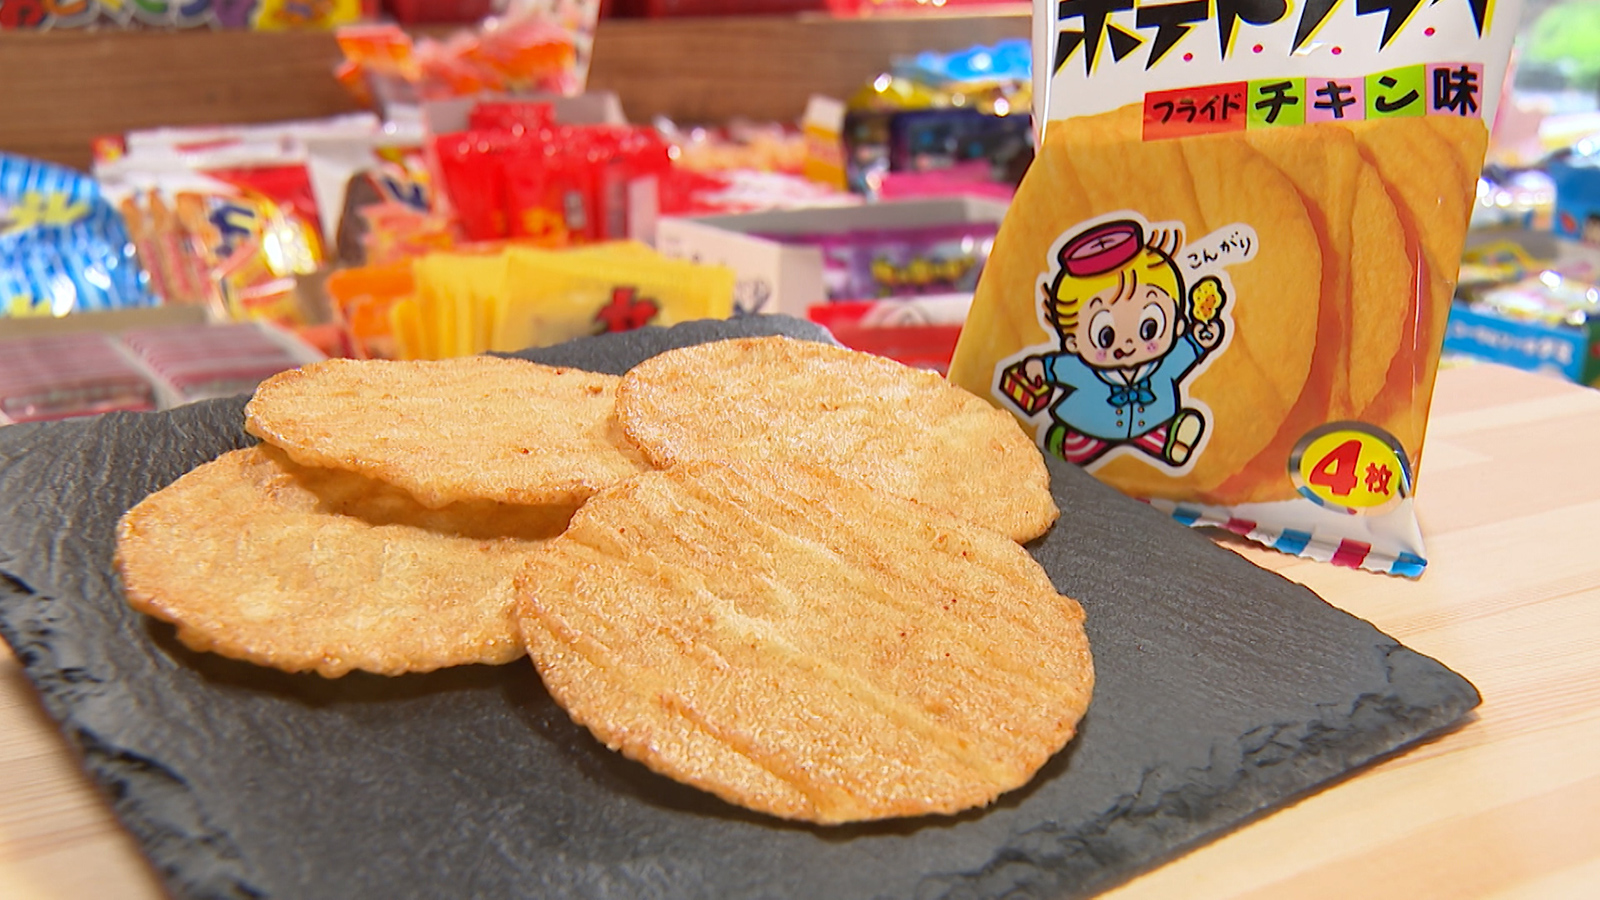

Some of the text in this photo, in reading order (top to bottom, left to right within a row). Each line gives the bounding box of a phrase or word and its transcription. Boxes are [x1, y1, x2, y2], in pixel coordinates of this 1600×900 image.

[1186, 230, 1252, 270] こんがり
[1309, 439, 1393, 497] 4枚
